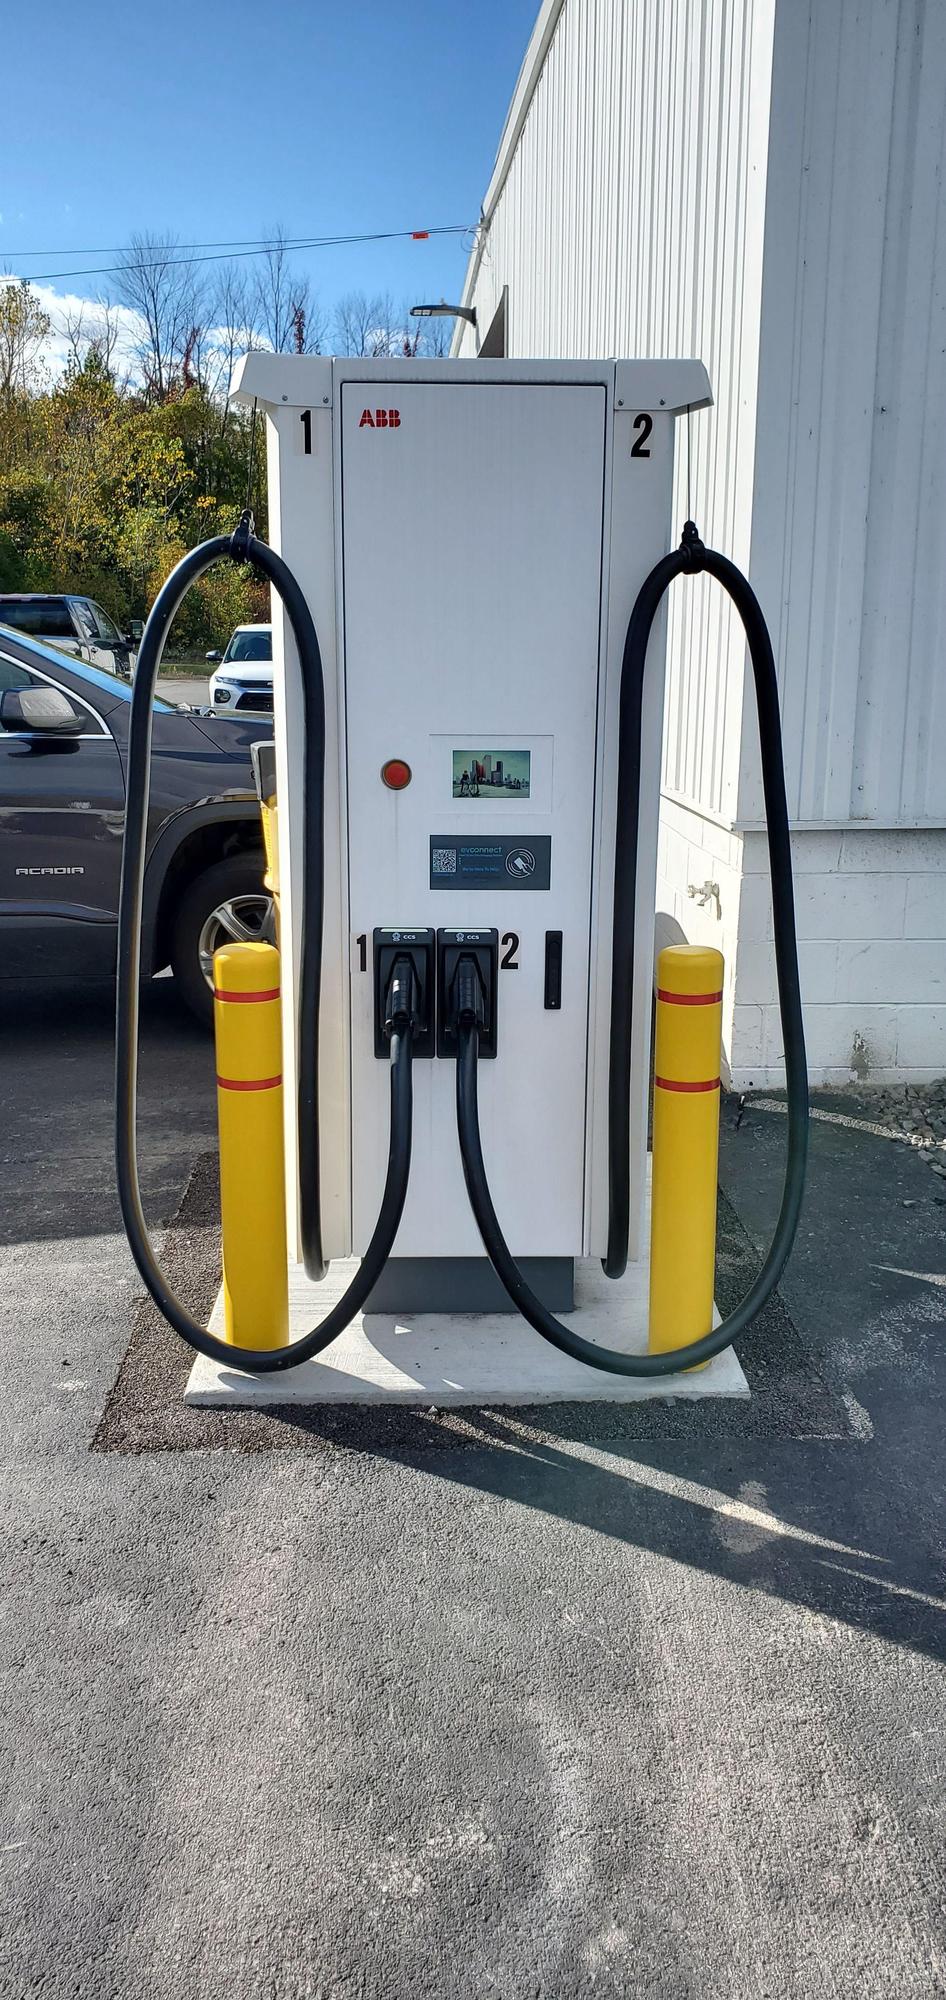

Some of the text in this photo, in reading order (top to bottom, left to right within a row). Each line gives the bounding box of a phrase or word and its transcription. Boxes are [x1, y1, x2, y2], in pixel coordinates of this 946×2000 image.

[300, 410, 311, 454] 1
[359, 409, 401, 427] ABB
[631, 413, 653, 457] 2
[15, 867, 84, 875] ACADIA
[356, 934, 367, 971] 1
[501, 932, 519, 969] 2
